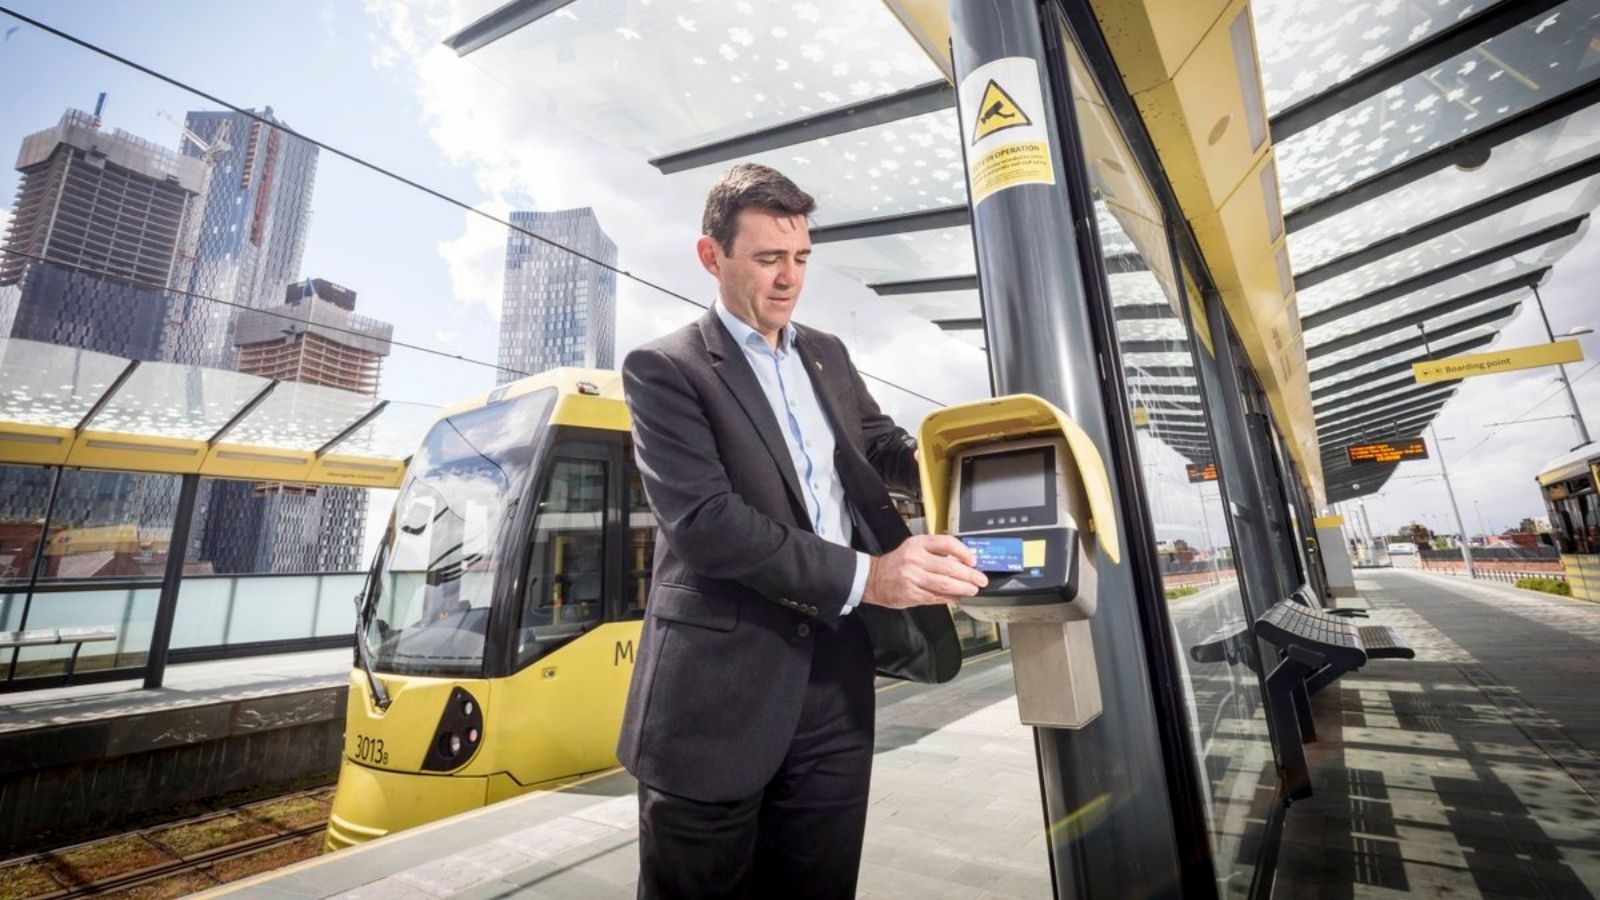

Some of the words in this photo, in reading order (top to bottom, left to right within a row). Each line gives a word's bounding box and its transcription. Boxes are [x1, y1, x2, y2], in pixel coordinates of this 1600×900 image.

[995, 145, 1039, 157] OPERATION
[1445, 364, 1485, 373] Boarding
[1486, 358, 1511, 368] point
